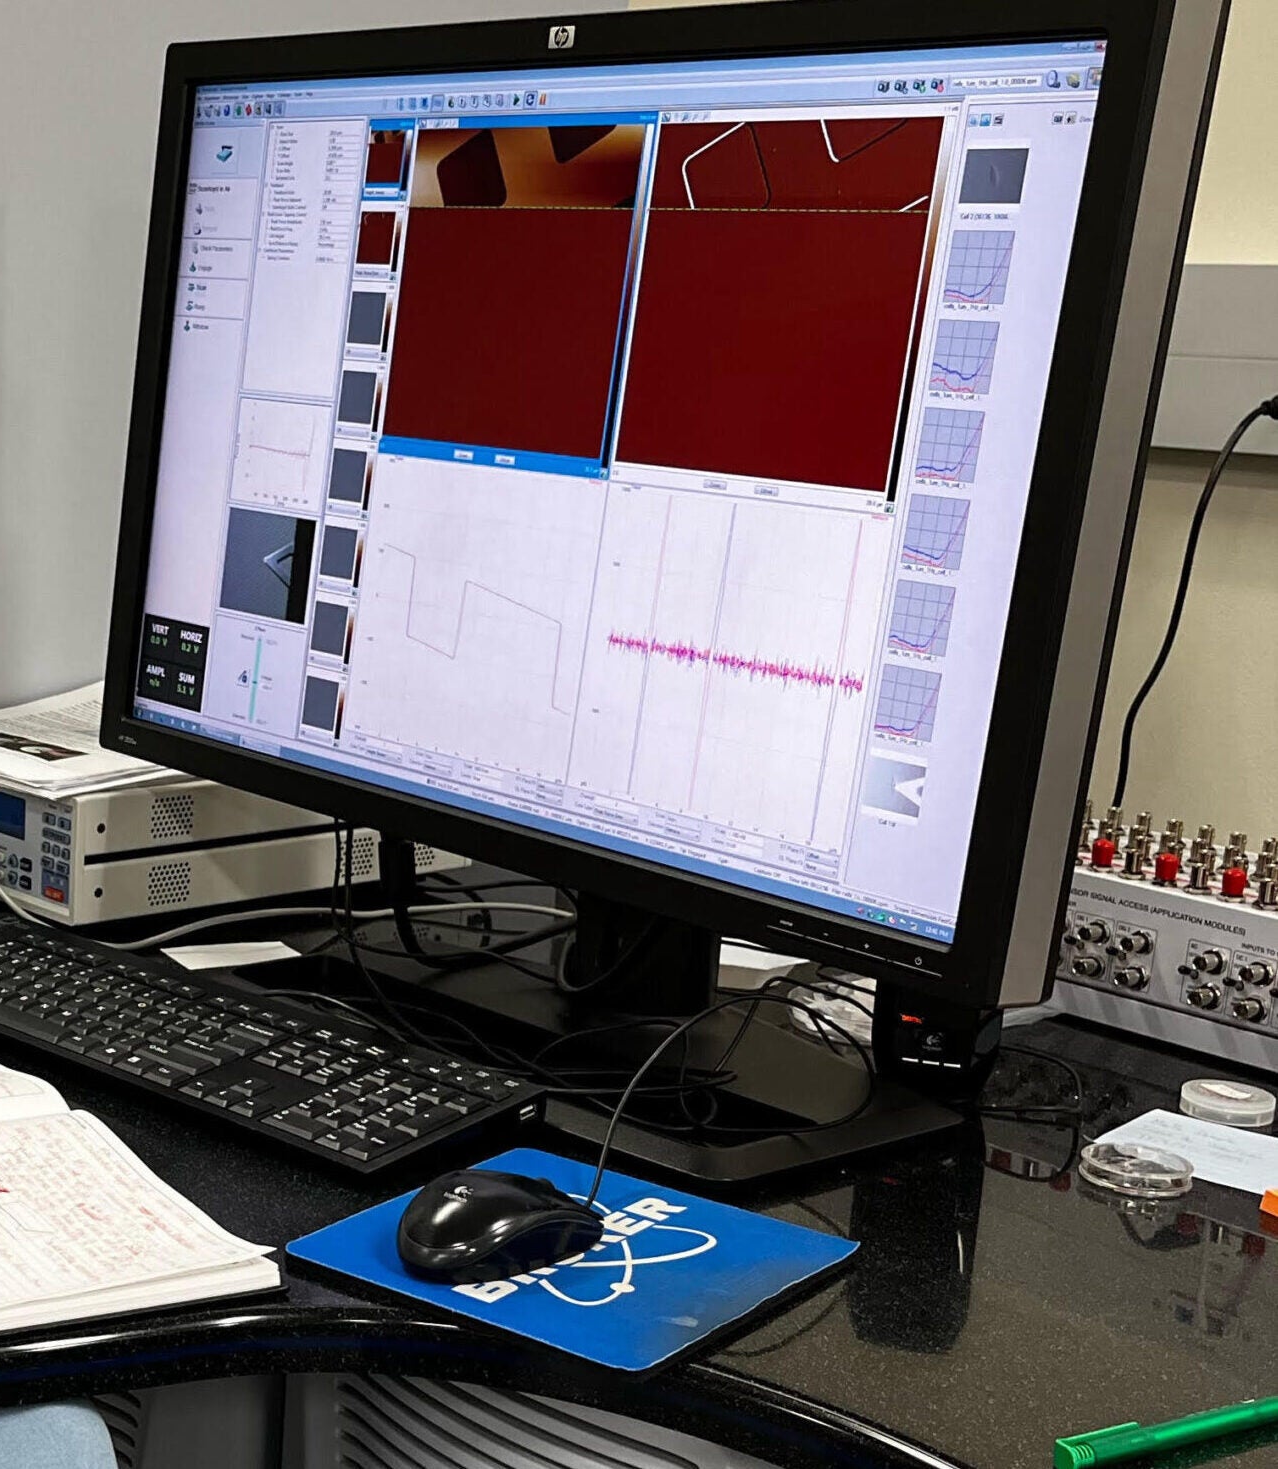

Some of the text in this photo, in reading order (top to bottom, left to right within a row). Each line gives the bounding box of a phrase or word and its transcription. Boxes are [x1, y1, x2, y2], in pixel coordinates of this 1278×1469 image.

[152, 624, 169, 635] VERT
[180, 630, 203, 643] HORIZ
[146, 665, 195, 684] AMPL SUM
[1090, 891, 1116, 904] SIGNAL
[1118, 899, 1149, 912] ACCESS
[1150, 906, 1202, 925] (APPLICATION
[1204, 920, 1246, 936] MODULES)
[1242, 942, 1275, 956] INPUTS TO
